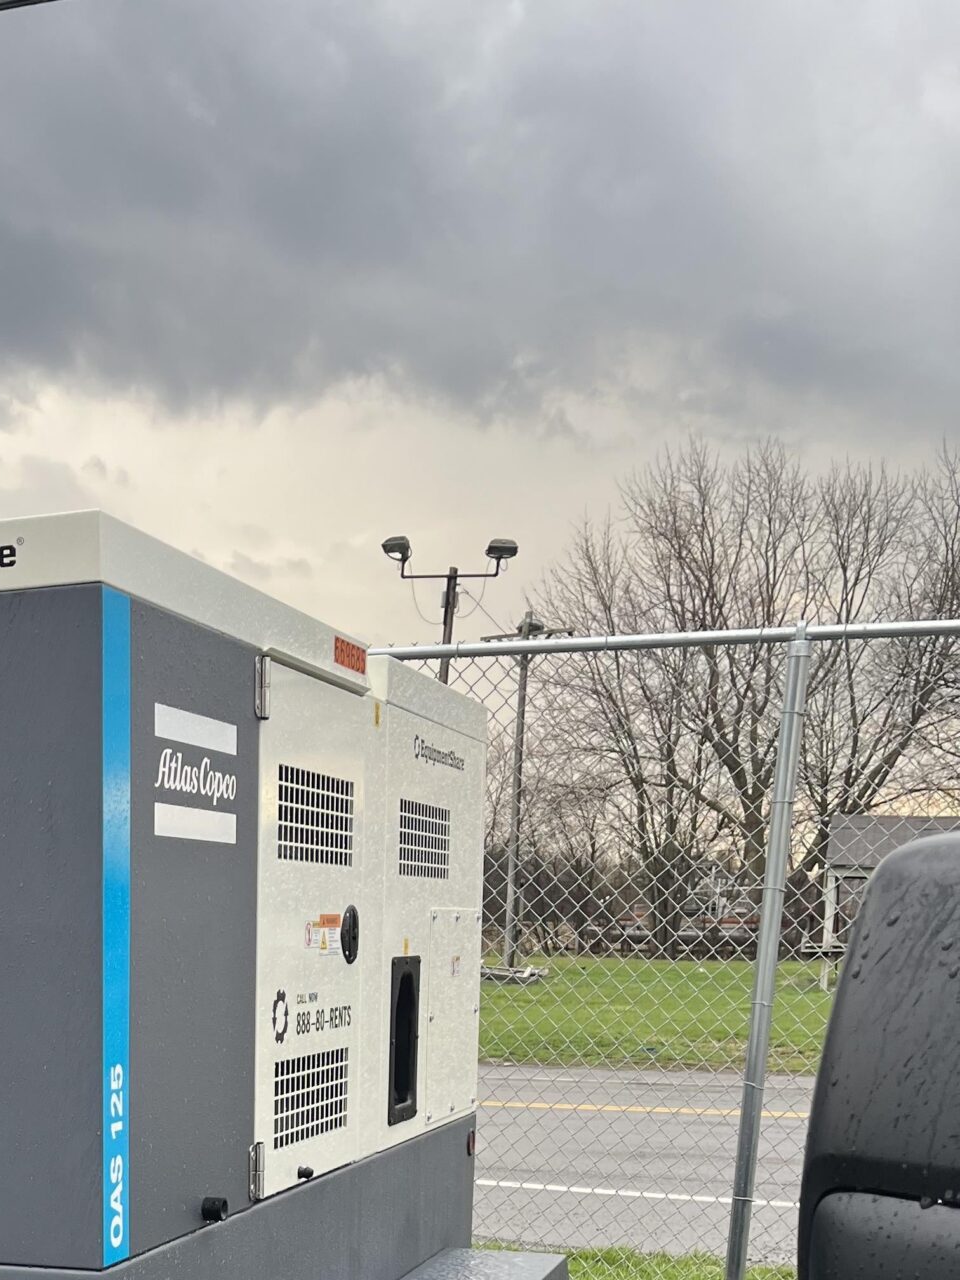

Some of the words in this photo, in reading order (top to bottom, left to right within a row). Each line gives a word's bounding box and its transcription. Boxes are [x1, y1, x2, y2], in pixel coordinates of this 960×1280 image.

[154, 748, 199, 794] Atlas
[200, 757, 237, 806] Copco
[296, 1005, 352, 1035] 888-80-RENTS
[110, 1063, 123, 1140] 125
[110, 1154, 123, 1248] QAS
